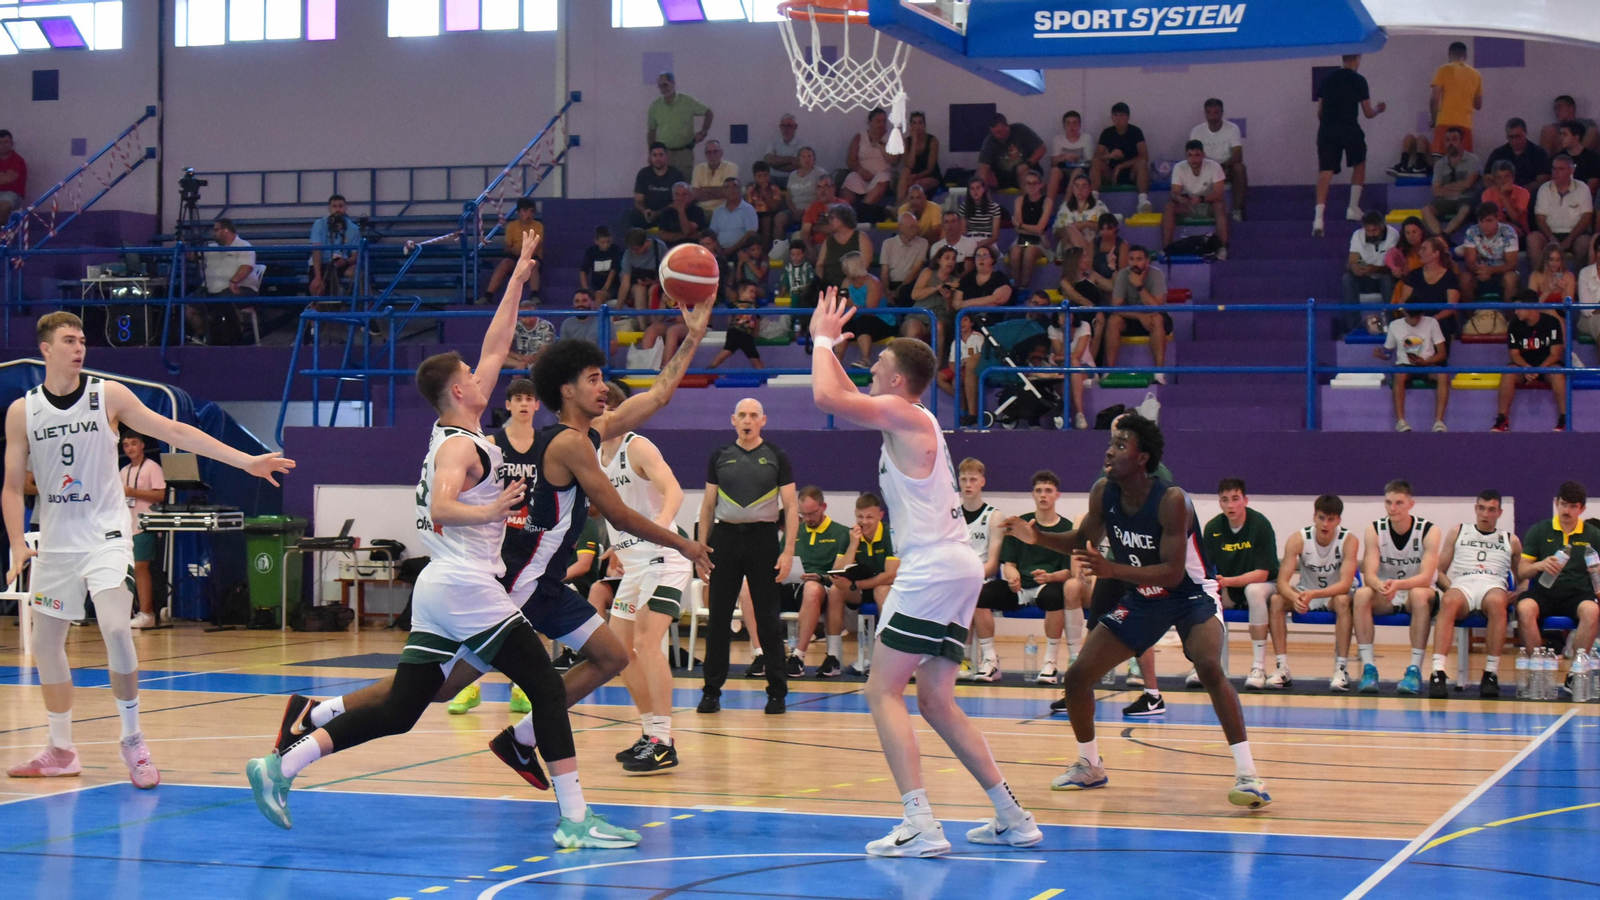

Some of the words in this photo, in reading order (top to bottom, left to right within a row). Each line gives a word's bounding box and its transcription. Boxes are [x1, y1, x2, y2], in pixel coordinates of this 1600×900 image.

[1034, 9, 1128, 31] SPORT
[1129, 3, 1247, 36] SYSTEM
[34, 421, 99, 441] LIETUVA
[61, 443, 74, 466] 9
[503, 462, 537, 478] FRANC
[48, 493, 91, 503] BIOVELA
[1113, 525, 1156, 550] FRANCE
[1460, 540, 1506, 553] LIETUVA
[1128, 553, 1142, 568] 9
[1379, 555, 1422, 566] LIETUVA
[1477, 550, 1487, 562] 0
[1317, 576, 1328, 589] 5
